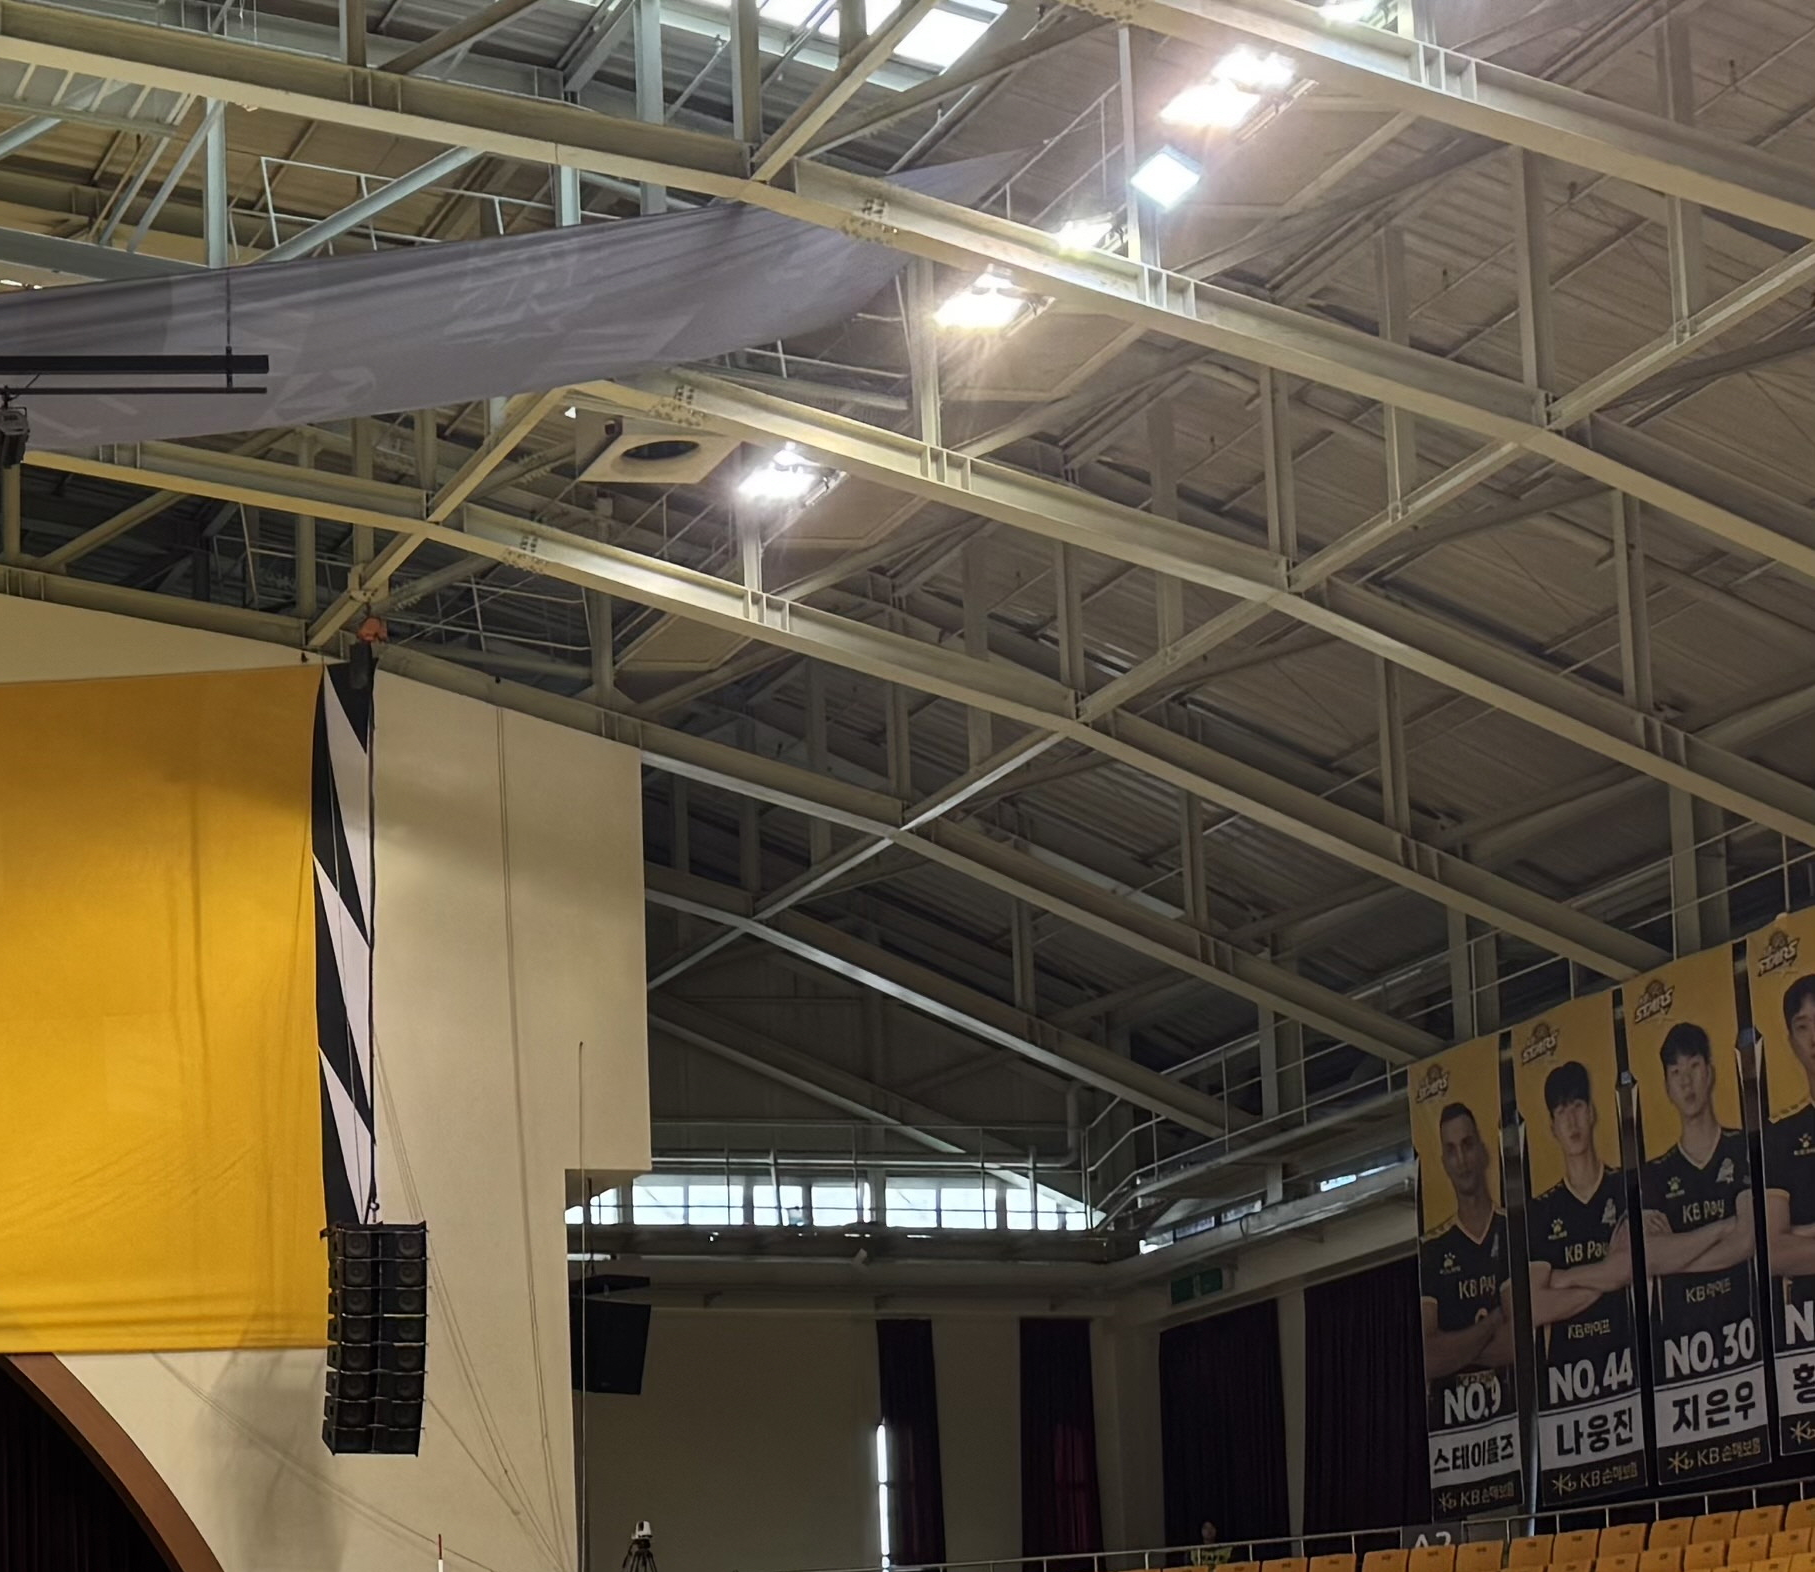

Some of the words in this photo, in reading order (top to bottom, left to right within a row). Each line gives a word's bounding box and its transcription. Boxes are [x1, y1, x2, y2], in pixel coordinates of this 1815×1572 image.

[1663, 1316, 1756, 1379] NO.30
[1548, 1348, 1633, 1404] NO.44
[1556, 1408, 1633, 1457] 나웅진
[1672, 1380, 1756, 1434] 지은우
[1433, 1433, 1514, 1475] 스테이플즈
